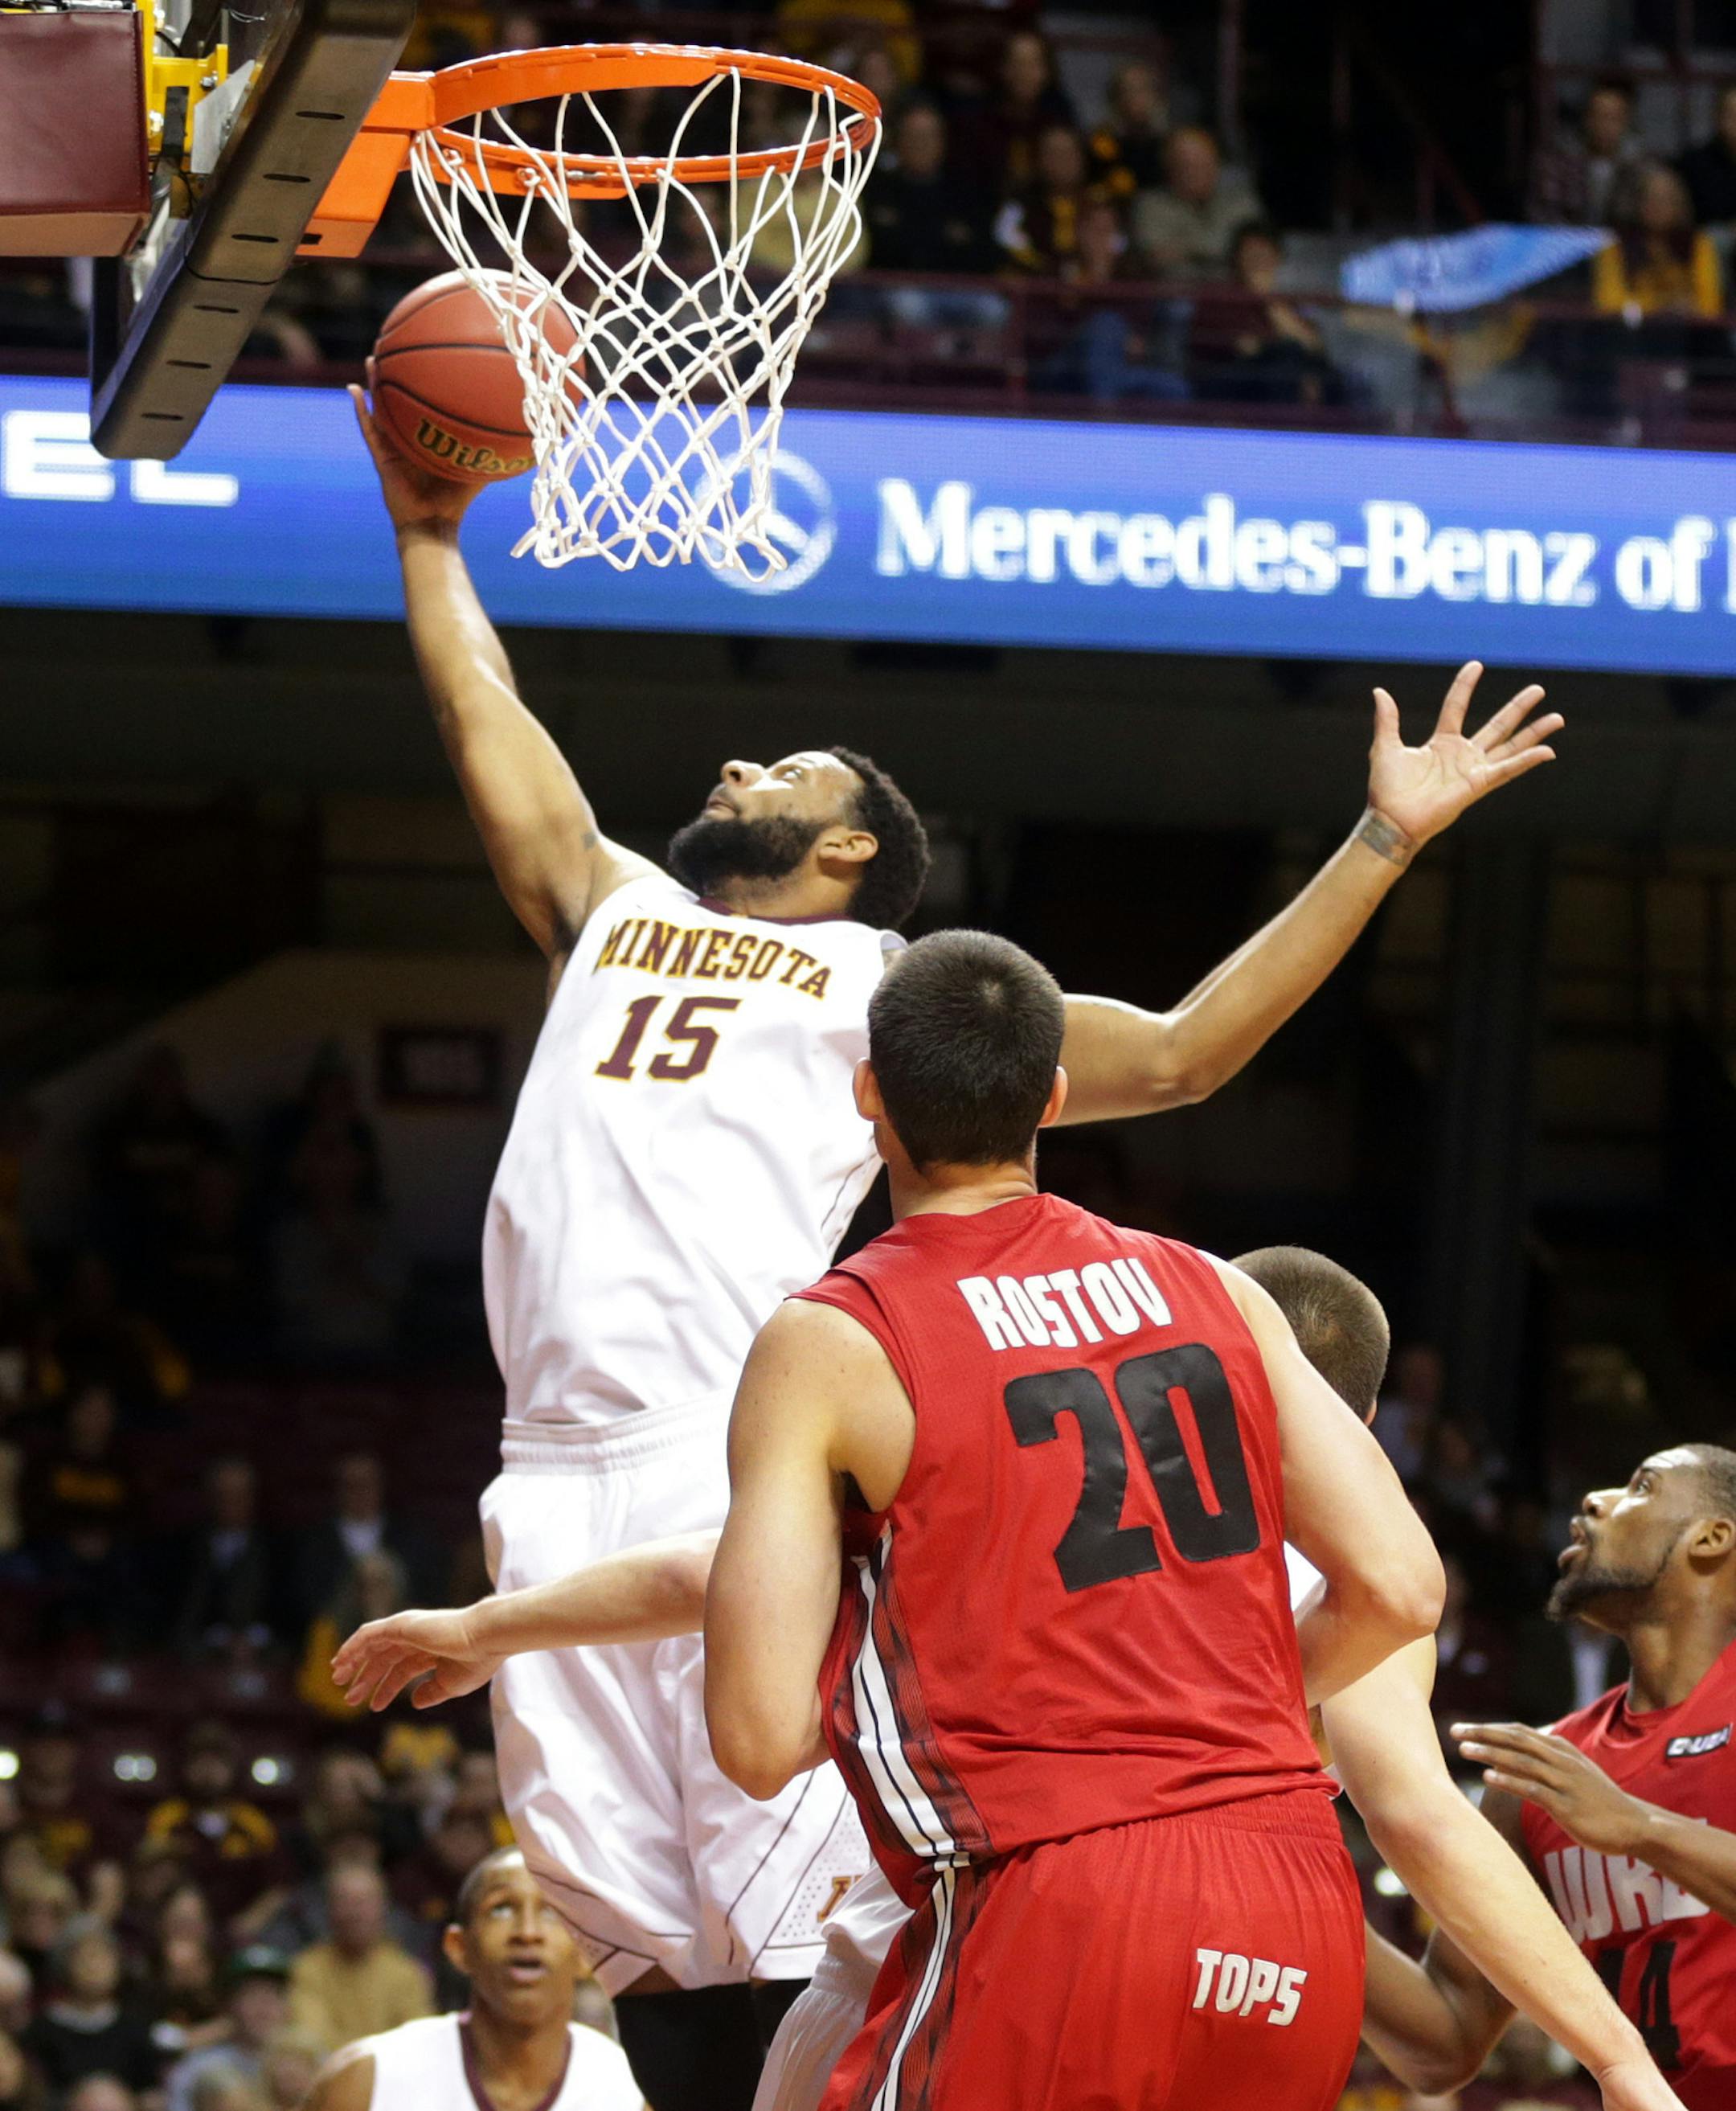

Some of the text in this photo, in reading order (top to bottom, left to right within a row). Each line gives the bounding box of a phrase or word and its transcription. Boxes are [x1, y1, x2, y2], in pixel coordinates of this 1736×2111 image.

[415, 417, 537, 474] Wilso
[878, 478, 1599, 607] Mercedes-Benz
[1615, 514, 1718, 613] of
[592, 918, 833, 1001] MINNESOTA
[594, 994, 743, 1083] 15
[956, 1257, 1173, 1351] ROSTOV
[1003, 1342, 1261, 1595] 20
[1192, 1948, 1308, 2027] TOPS
